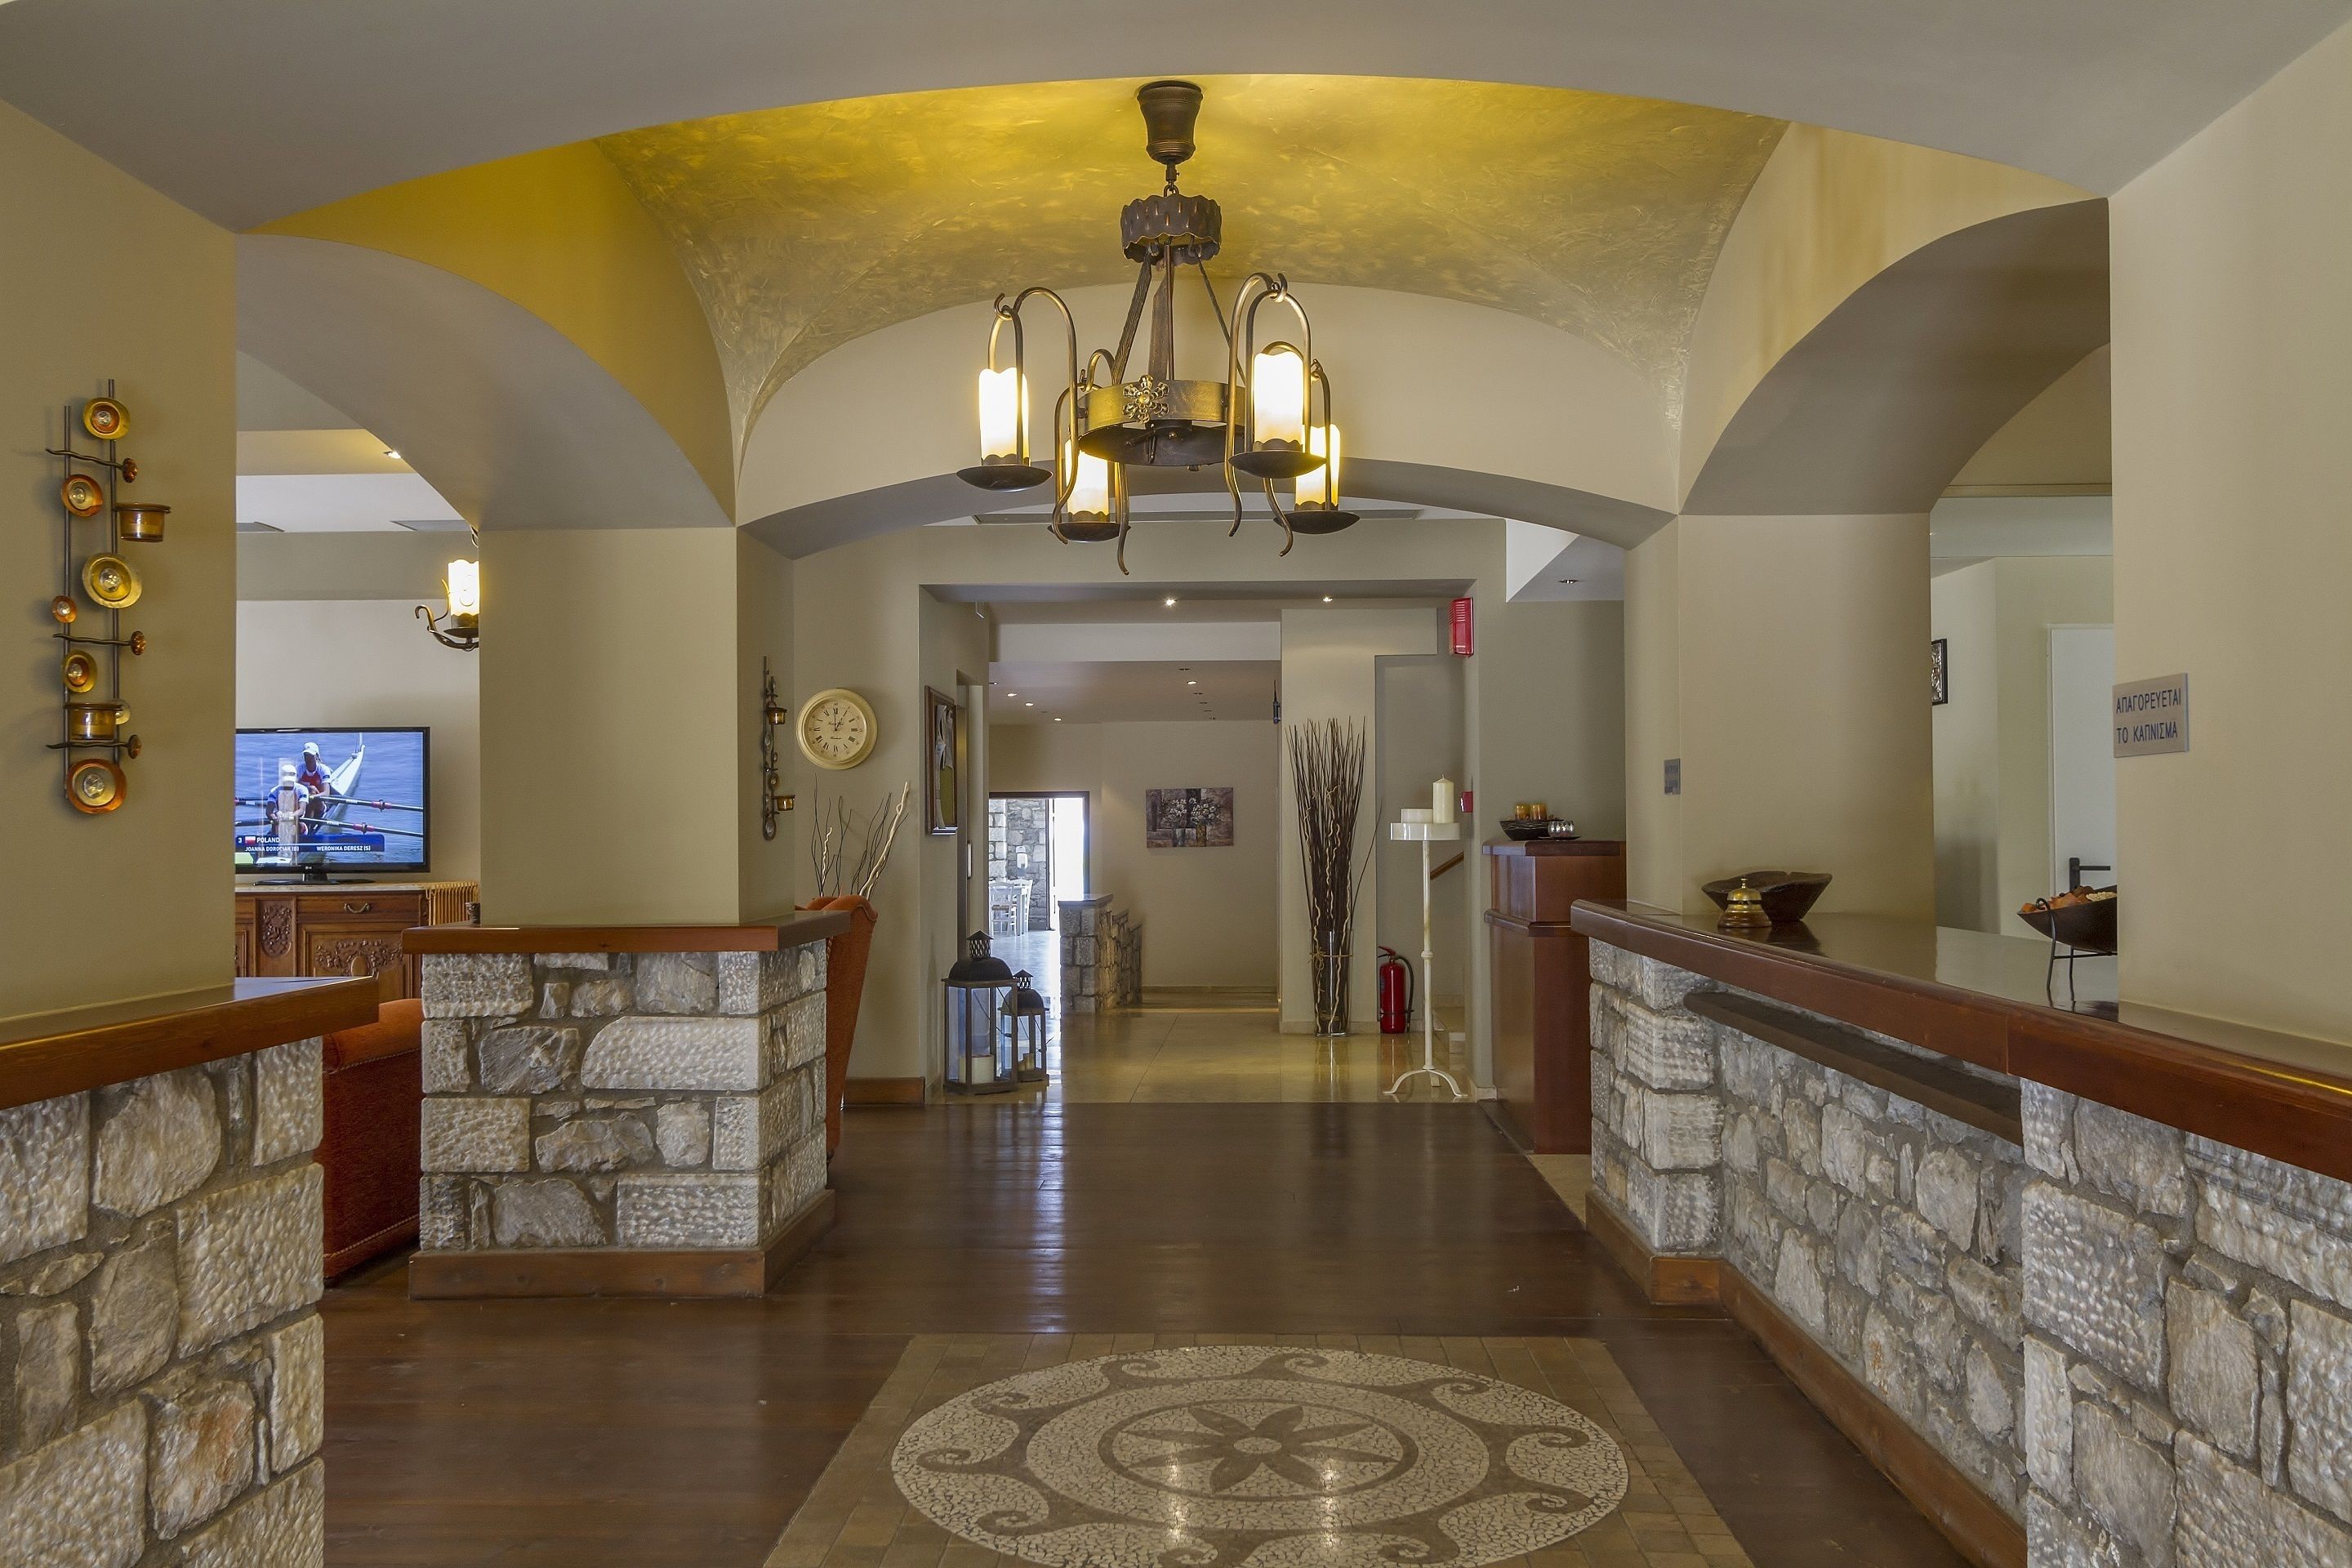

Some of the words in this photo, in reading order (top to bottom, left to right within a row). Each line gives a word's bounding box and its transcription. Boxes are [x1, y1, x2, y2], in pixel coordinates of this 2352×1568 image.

[2116, 688, 2181, 714] ΑΠΑΓΟΡΕΥΕΤΑΙ
[2116, 727, 2129, 743] ΤΟ
[2133, 721, 2178, 742] ΚΑΠΝΙΣΜΑ
